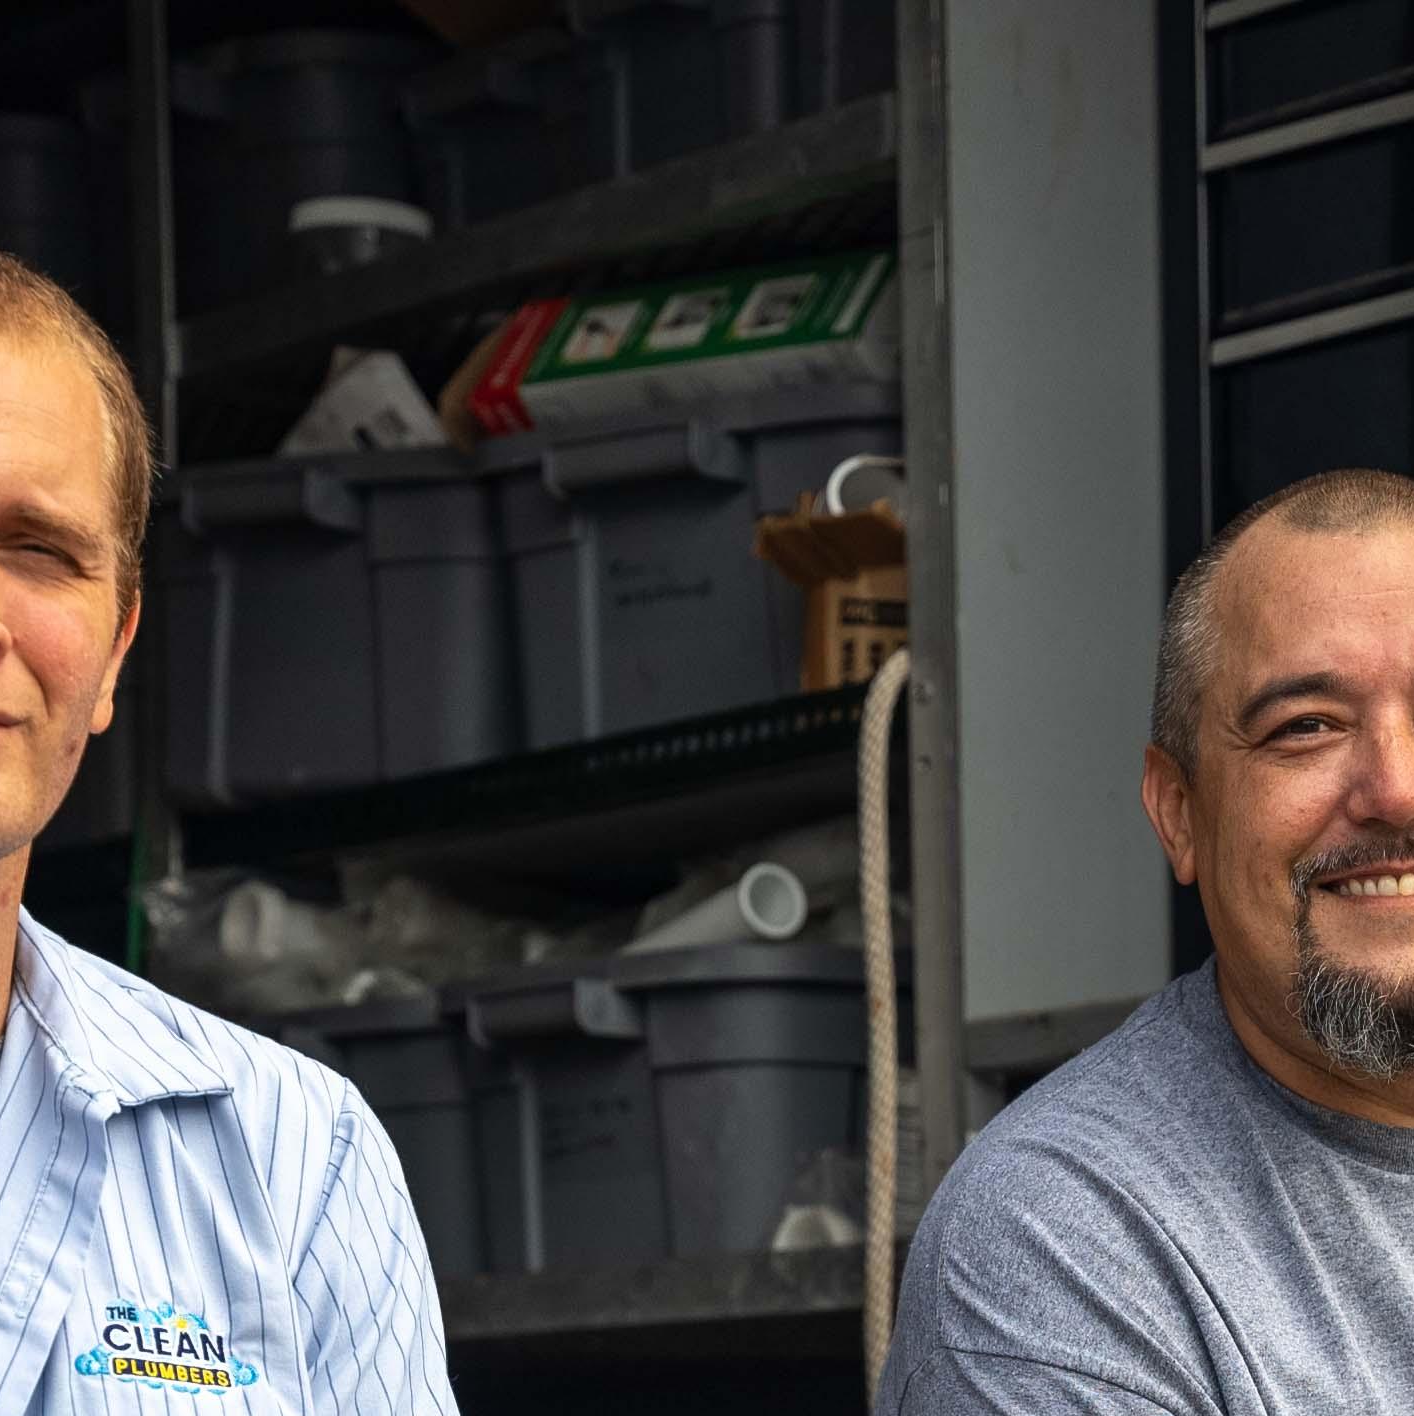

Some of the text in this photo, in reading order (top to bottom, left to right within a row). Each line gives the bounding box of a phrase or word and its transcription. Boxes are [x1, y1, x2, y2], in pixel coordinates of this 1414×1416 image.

[106, 1306, 137, 1321] THE
[102, 1322, 227, 1364] CLEAN
[115, 1359, 230, 1387] PLUMBERS
